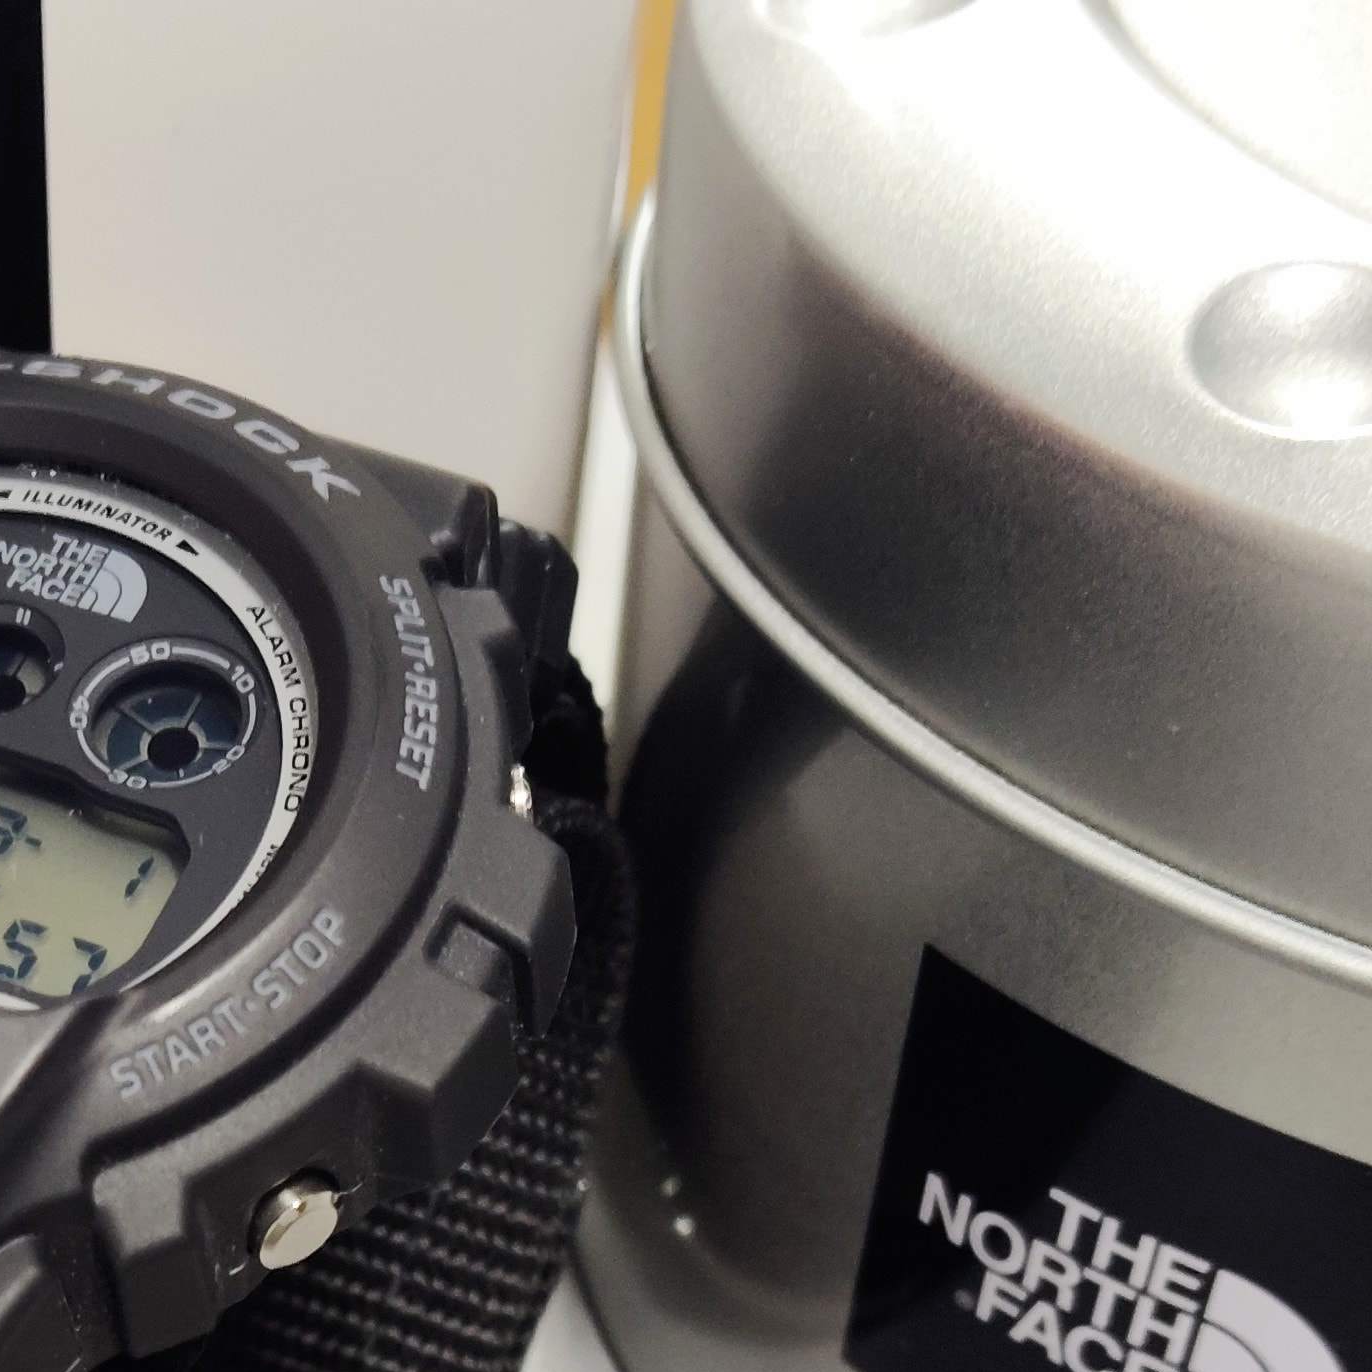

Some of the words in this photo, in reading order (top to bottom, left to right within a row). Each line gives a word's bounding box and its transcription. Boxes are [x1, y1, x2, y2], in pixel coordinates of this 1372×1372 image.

[21, 487, 174, 542] ILLUMINATOR
[50, 532, 110, 563] THE
[6, 567, 85, 607] FACE
[230, 665, 256, 694] 10
[246, 604, 303, 690] ALARM
[284, 696, 310, 813] CHRONO
[918, 1170, 1196, 1366] NORTH
[1048, 1185, 1212, 1313] THE
